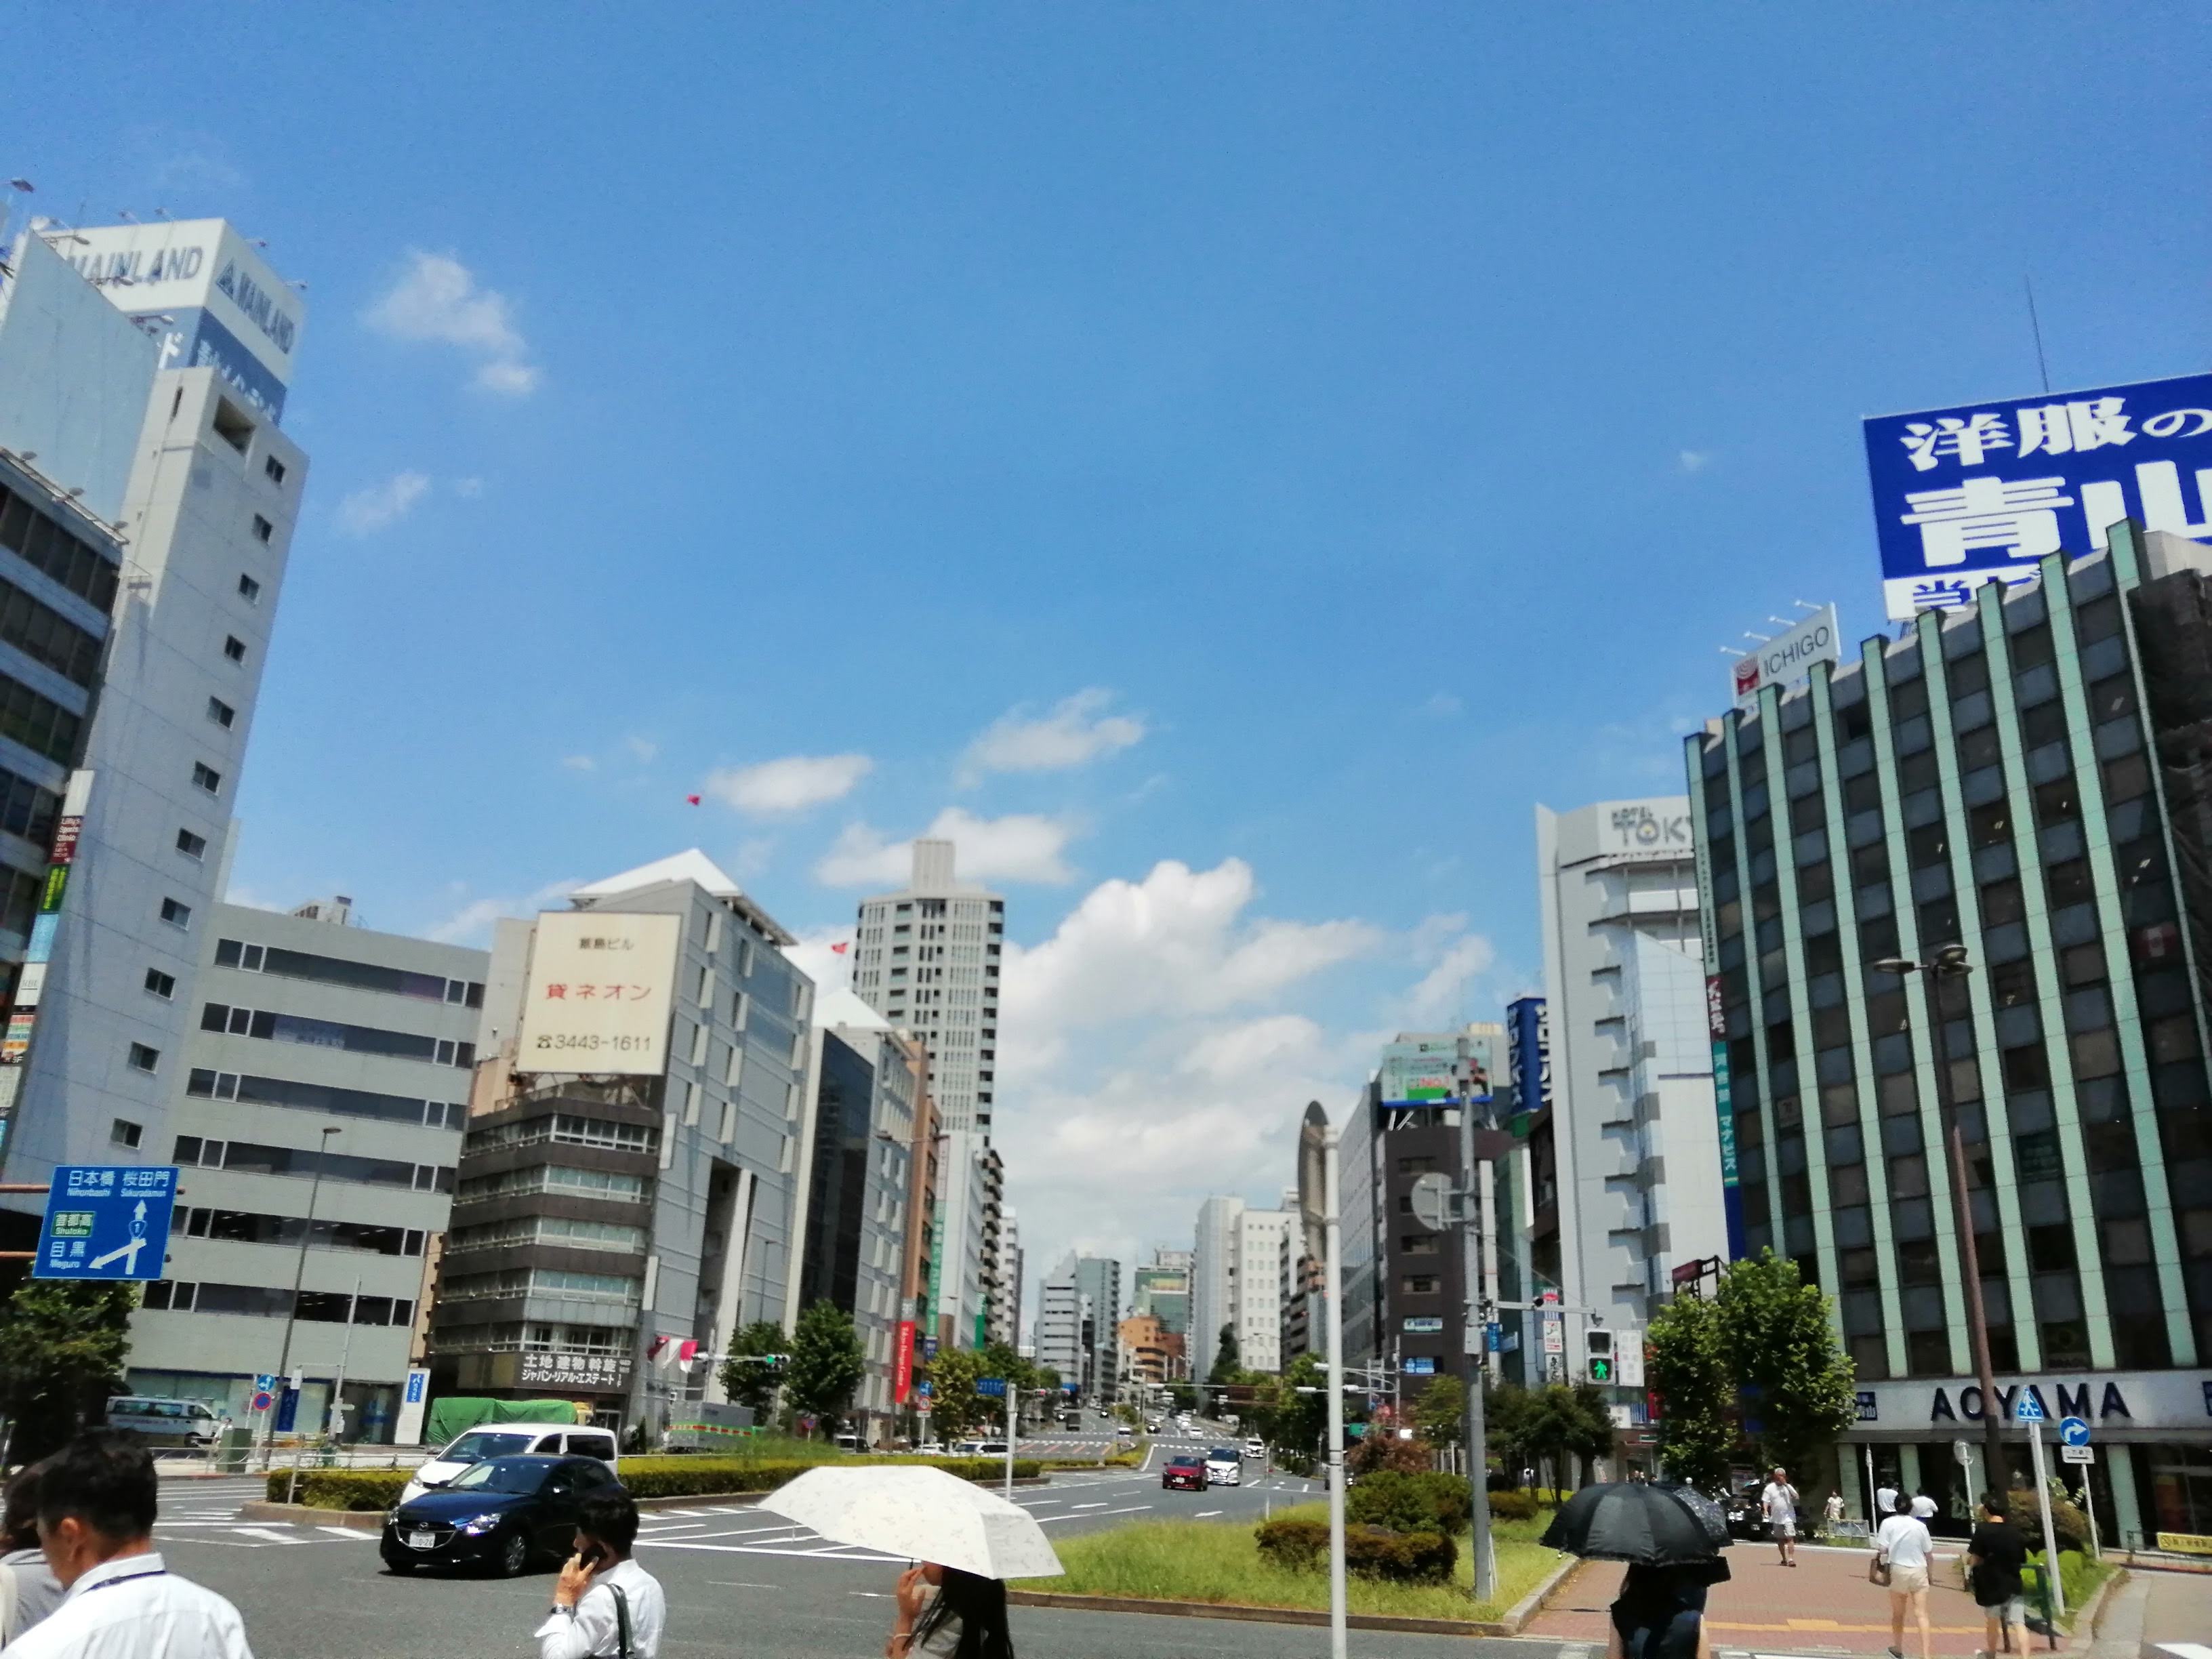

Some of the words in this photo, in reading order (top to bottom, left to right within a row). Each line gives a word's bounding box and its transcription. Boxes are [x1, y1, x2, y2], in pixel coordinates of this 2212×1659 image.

[1900, 396, 2212, 471] 洋服の
[1900, 460, 2212, 568] 青山
[1764, 626, 1829, 677] ICHIGO
[1613, 816, 1692, 846] TOK
[554, 1034, 651, 1050] 3443-1611
[68, 1170, 115, 1186] 日本橋
[123, 1170, 170, 1187] 桜田門
[56, 1213, 92, 1227] 首都高
[50, 1242, 86, 1257] 目黒
[49, 1259, 81, 1269] Meguro
